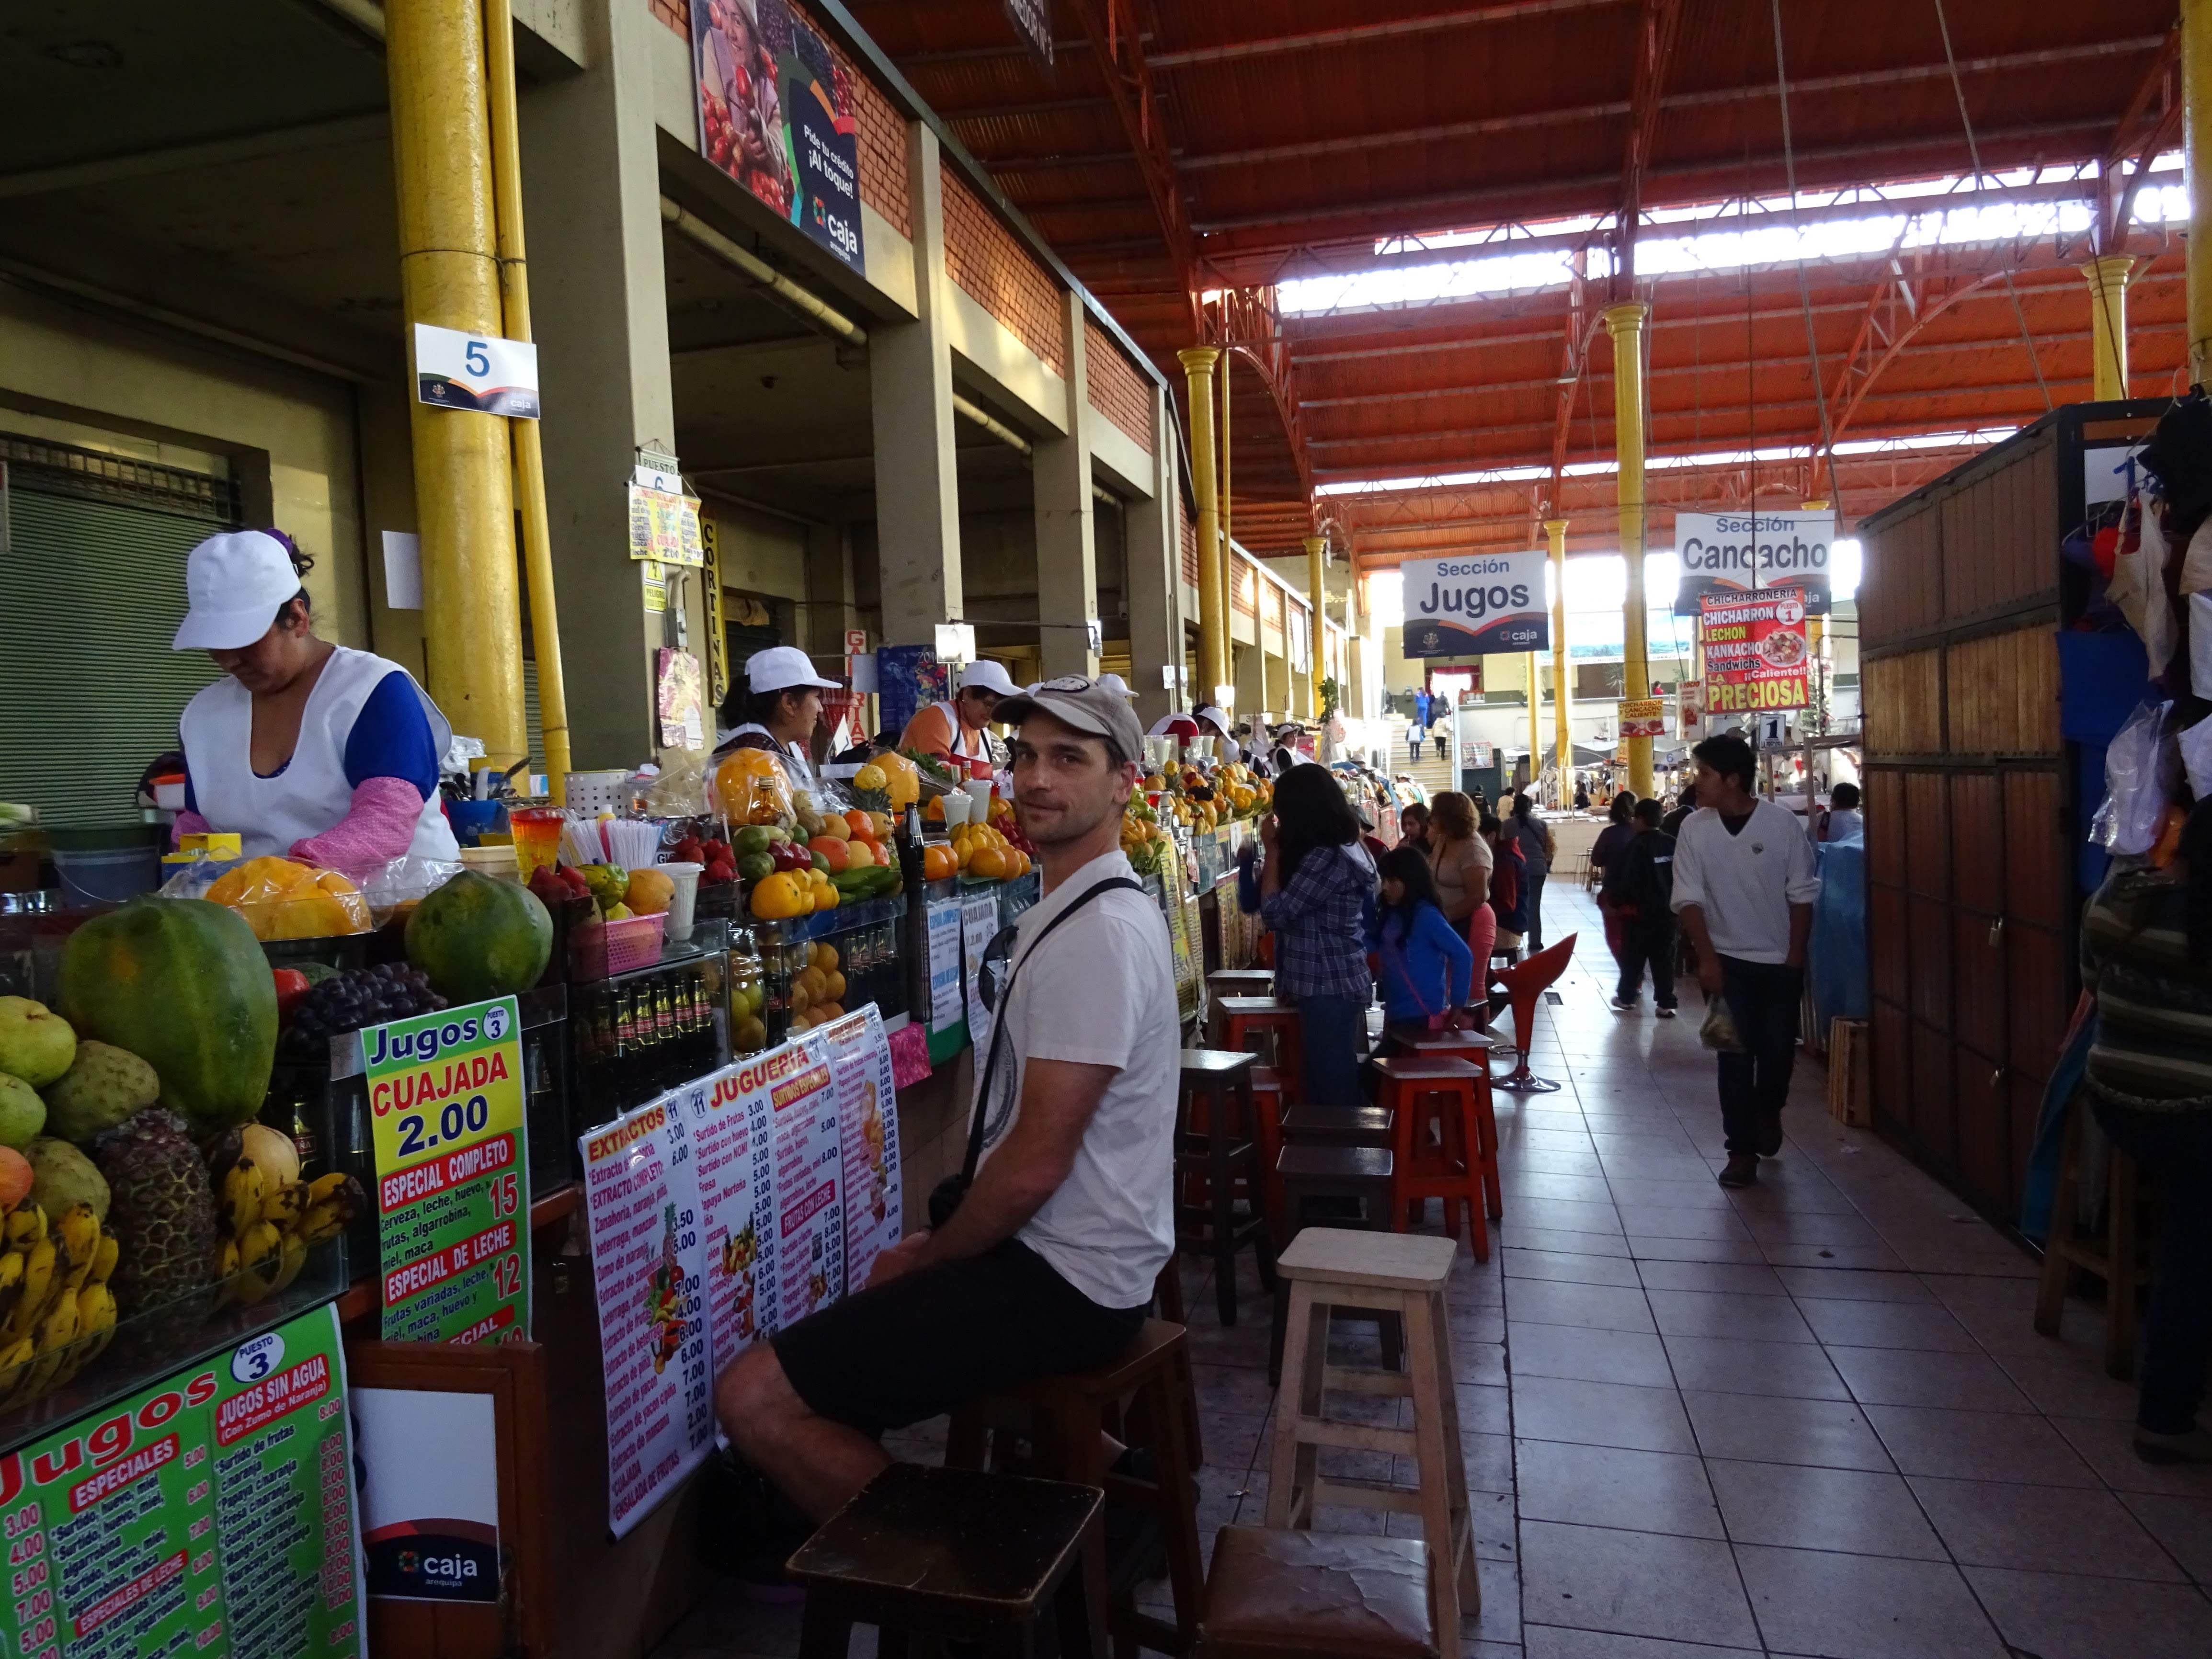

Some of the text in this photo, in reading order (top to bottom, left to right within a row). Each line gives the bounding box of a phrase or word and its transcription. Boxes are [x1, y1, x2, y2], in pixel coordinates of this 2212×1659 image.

[804, 124, 854, 180] Pide tu crédito
[824, 160, 854, 200] toque!
[827, 214, 858, 255] caja
[466, 341, 490, 377] 5
[510, 399, 532, 409] caja
[644, 458, 675, 475] PUESTO
[1716, 516, 1795, 533] Sección
[1682, 535, 1828, 570] Cancacho
[1437, 558, 1510, 577] Sección
[1420, 582, 1530, 619] Jugos
[1707, 589, 1798, 605] CHICHARRONERIA
[704, 523, 725, 704] CORTINAS
[1703, 606, 1774, 625] CHICHARRON
[1785, 610, 1794, 623] 1
[1511, 629, 1538, 641] caja
[1705, 626, 1746, 642] LECHON
[1706, 641, 1763, 659] KANKACHO
[1707, 658, 1761, 673] Sandwichs
[1707, 673, 1725, 683] LA
[1708, 678, 1805, 711] PRECIOSA
[1766, 719, 1779, 739] 1
[963, 901, 993, 926] CUAJADA
[371, 1019, 478, 1065] Jugos
[491, 1020, 501, 1039] 3
[373, 1051, 509, 1117] CUAJADA
[748, 1099, 764, 1116] 3.00
[398, 1095, 488, 1158] 2.00
[666, 1122, 684, 1145] 3.00
[696, 1111, 745, 1142] Surtido de Frutas
[698, 1140, 719, 1159] Surtido
[698, 1158, 720, 1178] Surtido
[733, 1142, 748, 1159] NONI
[752, 1147, 769, 1166] 5.00
[821, 1146, 838, 1164] 8.00
[384, 1139, 508, 1208] ESPECIAL COMPLETO
[753, 1163, 770, 1182] 5.00
[422, 1183, 484, 1215] leche, huevo,
[489, 1172, 518, 1220] 15
[593, 1178, 632, 1210] EXTRACTO
[754, 1179, 771, 1198] 5.00
[755, 1195, 771, 1215] 5.00
[823, 1205, 840, 1223] 7.00
[412, 1205, 471, 1239] algarrobina,
[387, 1224, 511, 1302] ESPECIAL DE LECHE
[405, 1239, 433, 1261] maca
[414, 1283, 461, 1310] variadas,
[462, 1269, 489, 1289] leche,
[493, 1252, 521, 1301] 12
[407, 1313, 440, 1334] maca,
[442, 1297, 470, 1314] huevo
[471, 1291, 477, 1302] y
[239, 1336, 274, 1357] PUESTO
[249, 1352, 270, 1380] 3
[683, 1360, 705, 1386] 7.00
[219, 1356, 327, 1427] JUGOS SIN AGUA
[684, 1381, 706, 1408] 7.00
[687, 1402, 708, 1430] 2.00
[0, 1370, 218, 1507] Jugos
[689, 1424, 708, 1451] 7.00
[76, 1439, 174, 1508] ESPECIALES
[5, 1503, 40, 1538] 3.00
[10, 1533, 44, 1565] 4.00
[13, 1560, 47, 1596] 5.00
[424, 1554, 478, 1579] caja
[425, 1578, 463, 1588] arequipa
[16, 1589, 51, 1625] 7.00
[21, 1617, 55, 1653] 5.00
